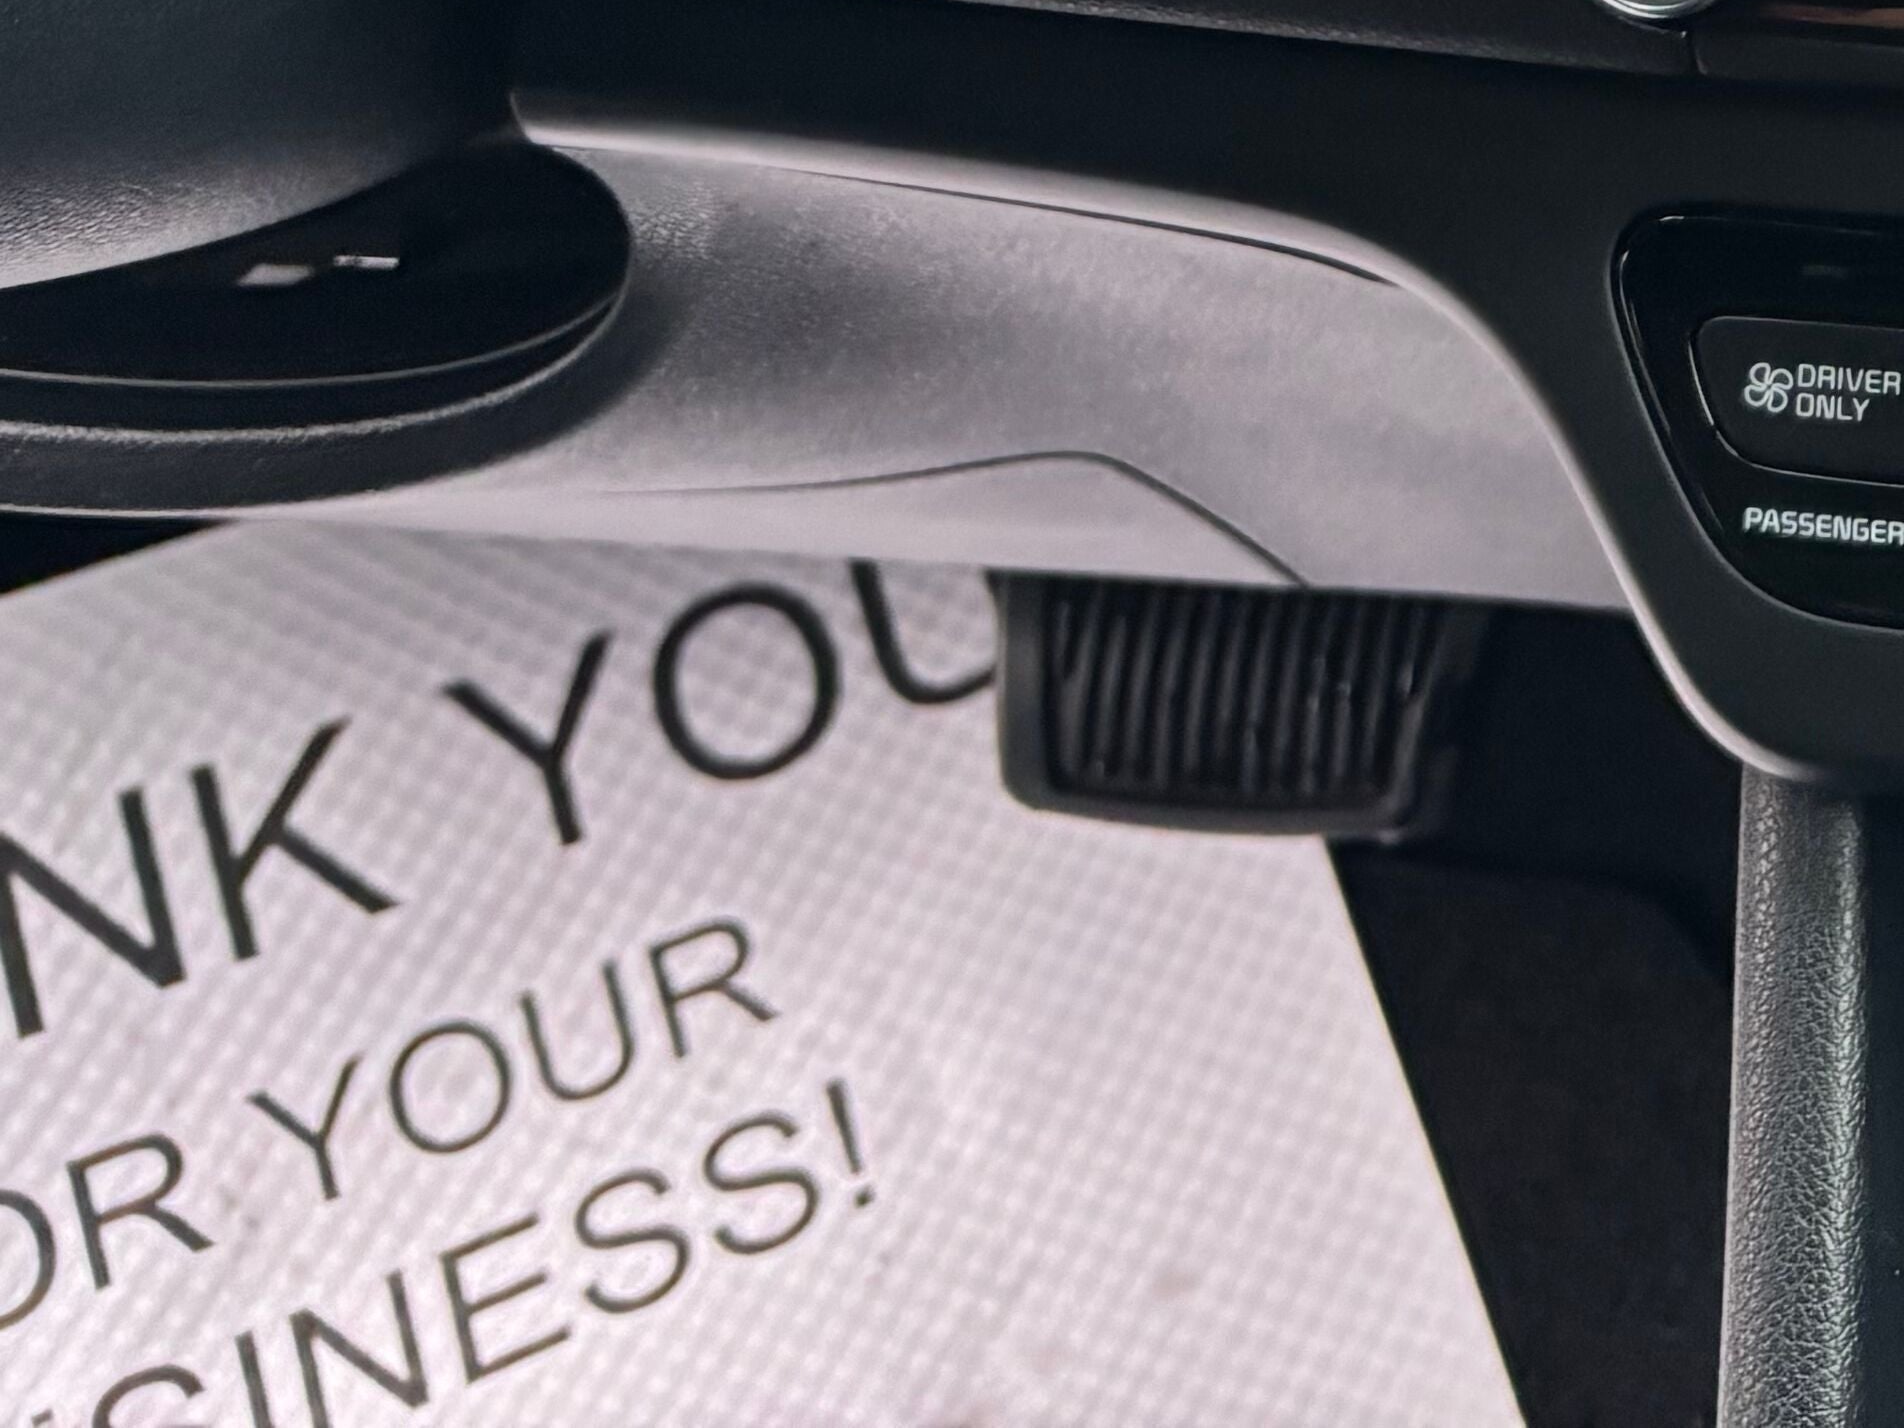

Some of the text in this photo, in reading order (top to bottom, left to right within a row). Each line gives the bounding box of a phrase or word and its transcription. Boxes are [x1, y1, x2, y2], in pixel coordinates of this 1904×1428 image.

[1796, 363, 1902, 396] DRIVER
[1795, 393, 1871, 422] ONLY
[1744, 507, 1904, 545] PASSENGER
[247, 919, 777, 1200] YOUR
